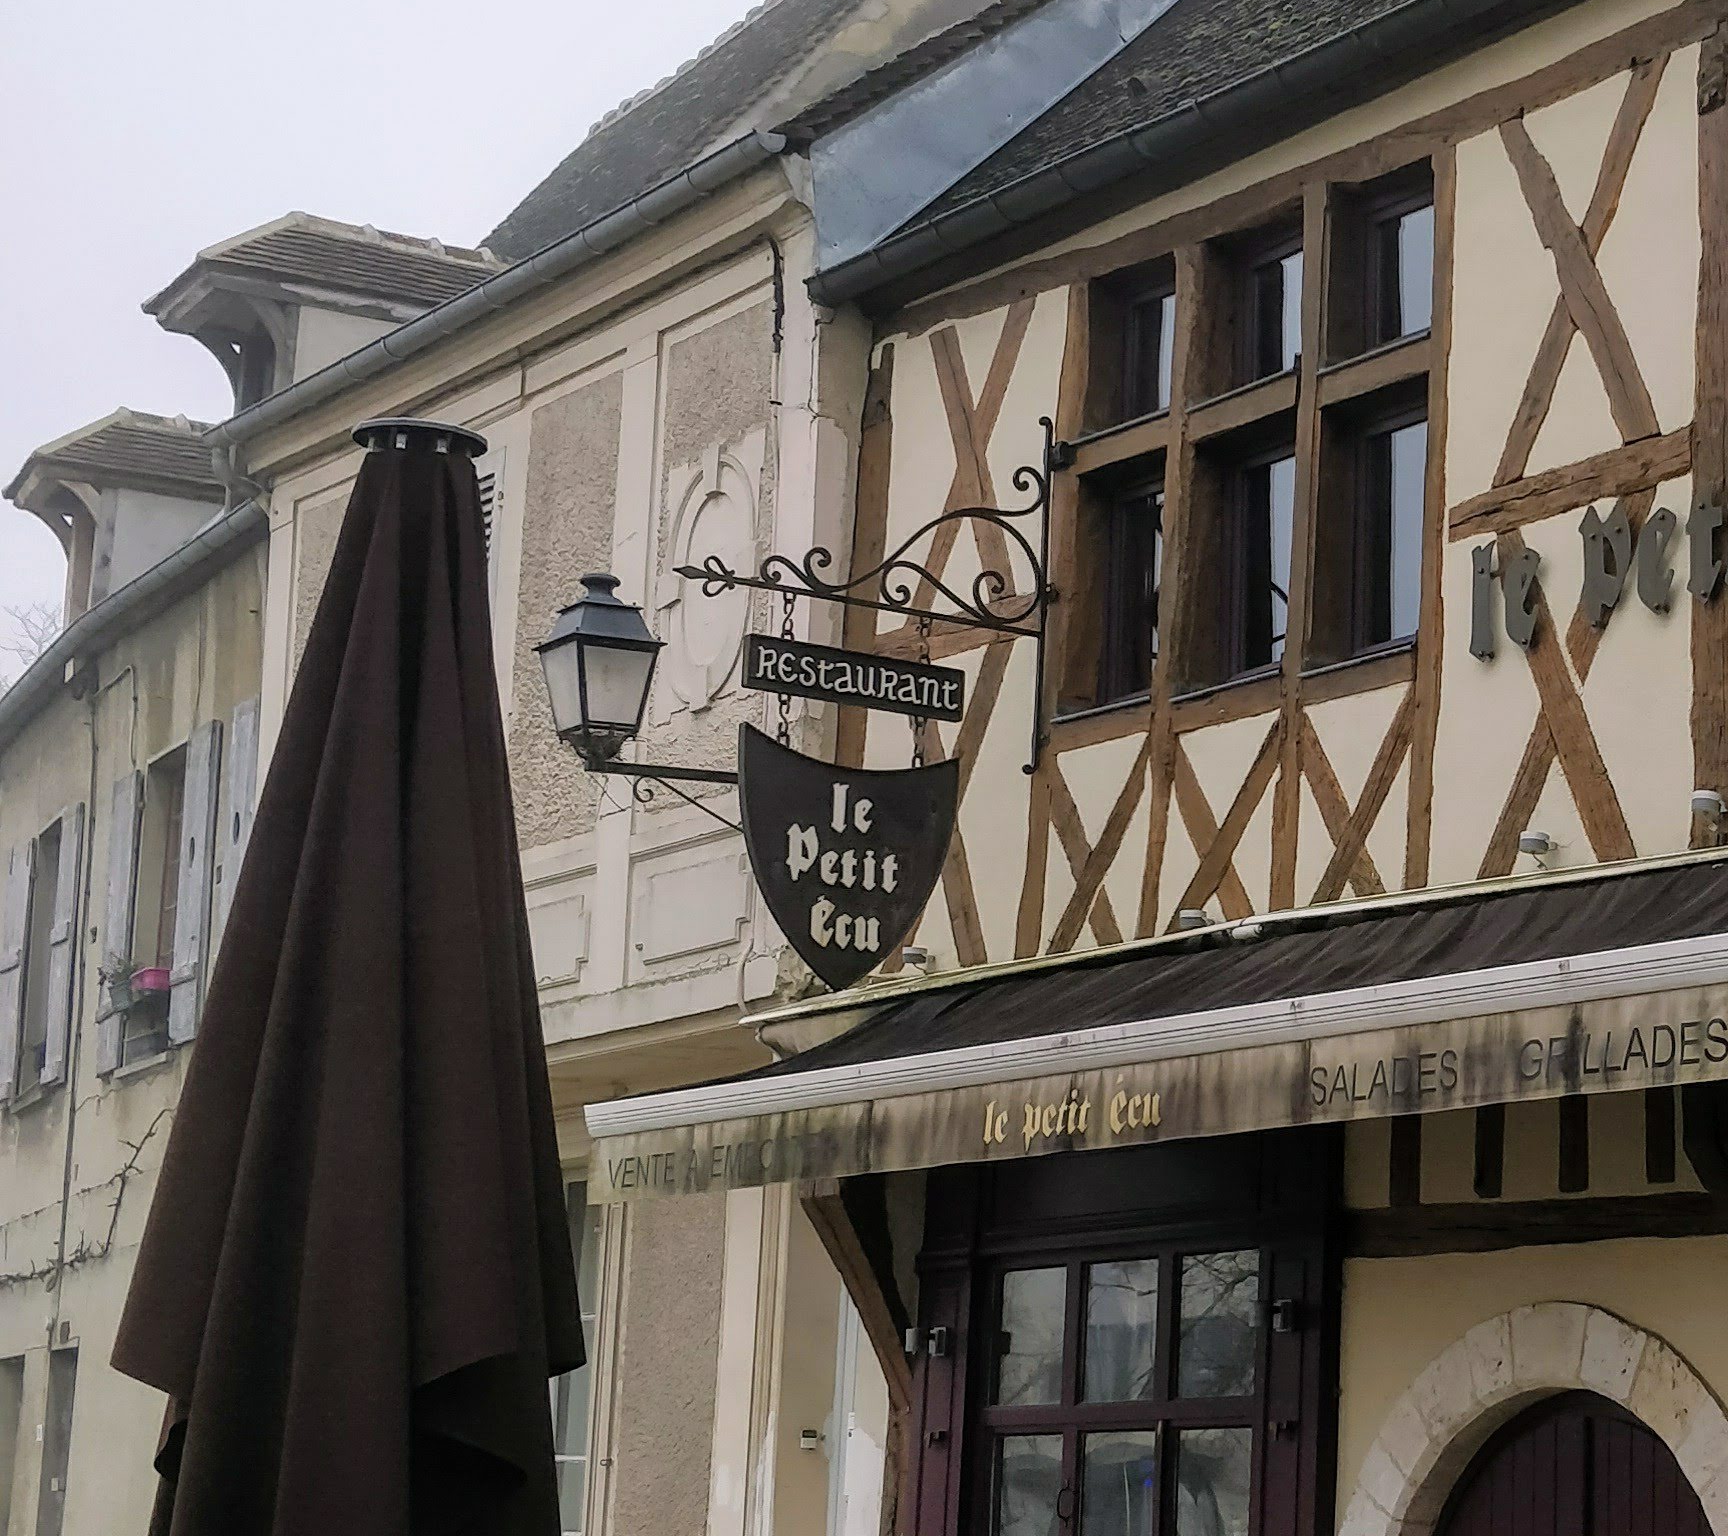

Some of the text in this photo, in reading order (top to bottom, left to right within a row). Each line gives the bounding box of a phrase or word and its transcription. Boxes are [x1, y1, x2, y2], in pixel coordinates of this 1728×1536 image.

[1309, 1048, 1459, 1107] SALADES
[982, 1100, 1009, 1145] le
[1020, 1087, 1092, 1154] petit
[607, 1151, 676, 1190] VENTE
